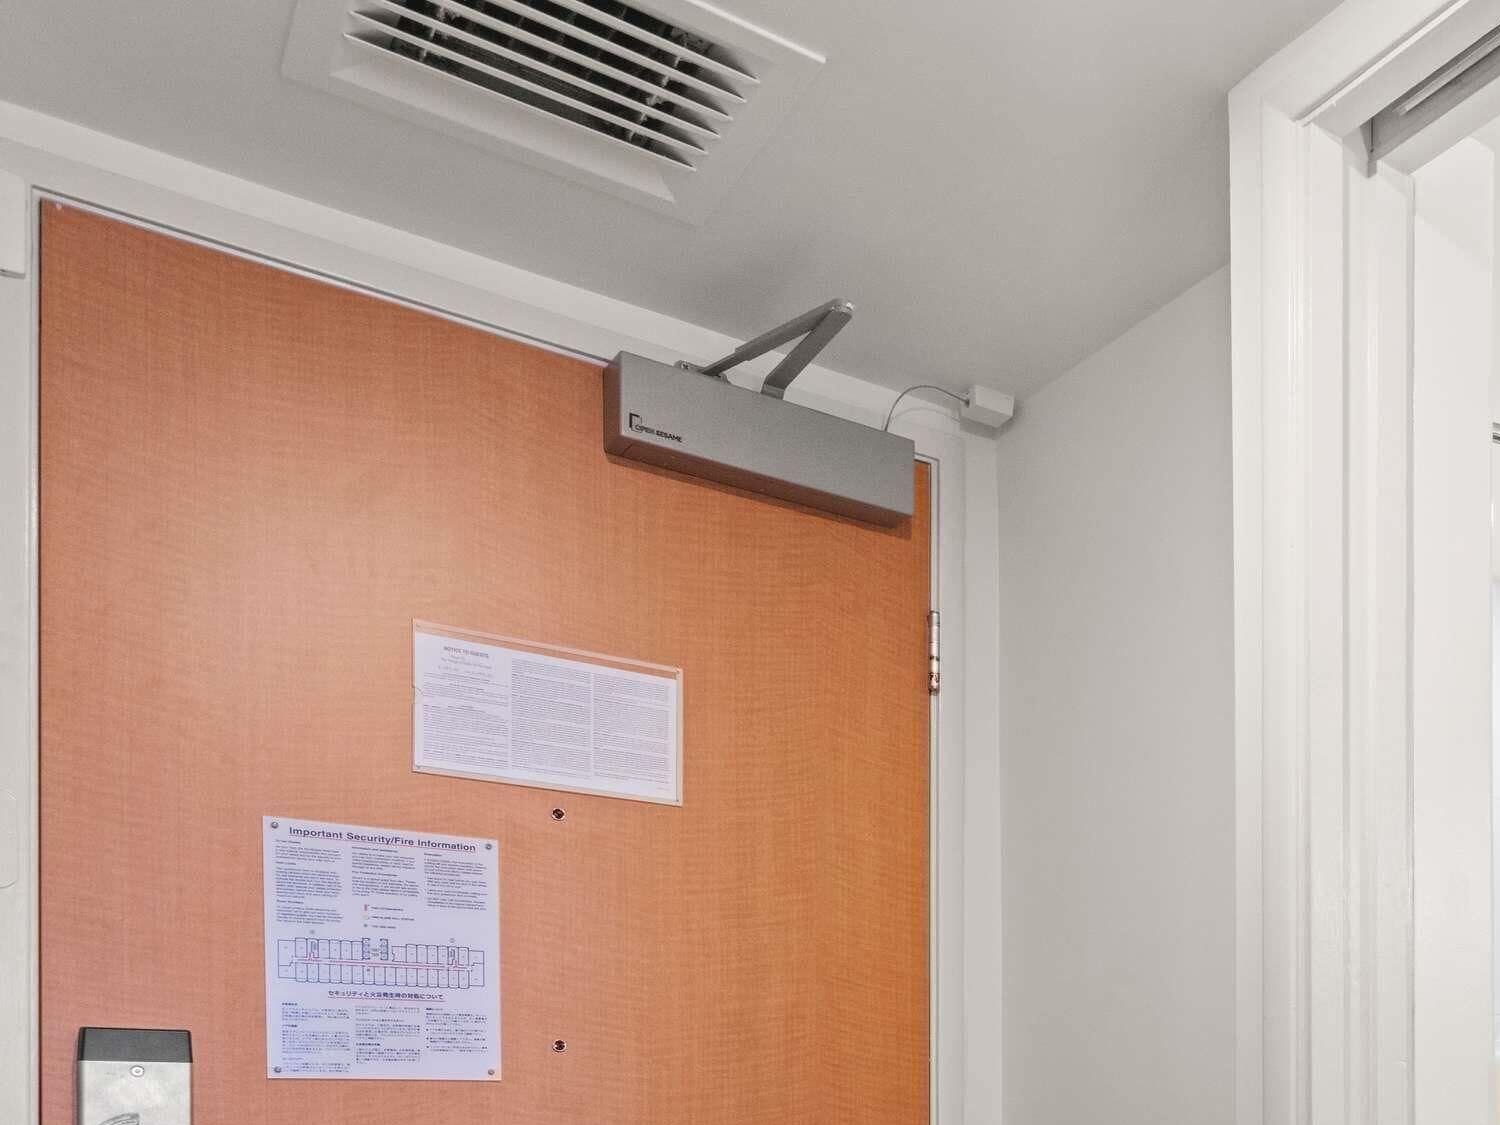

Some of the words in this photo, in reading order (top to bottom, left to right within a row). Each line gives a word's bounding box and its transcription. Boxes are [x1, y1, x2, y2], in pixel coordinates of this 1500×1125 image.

[655, 430, 682, 443] SESAME
[289, 827, 343, 839] Important
[346, 832, 414, 845] Security/Fire
[417, 840, 476, 852] Information
